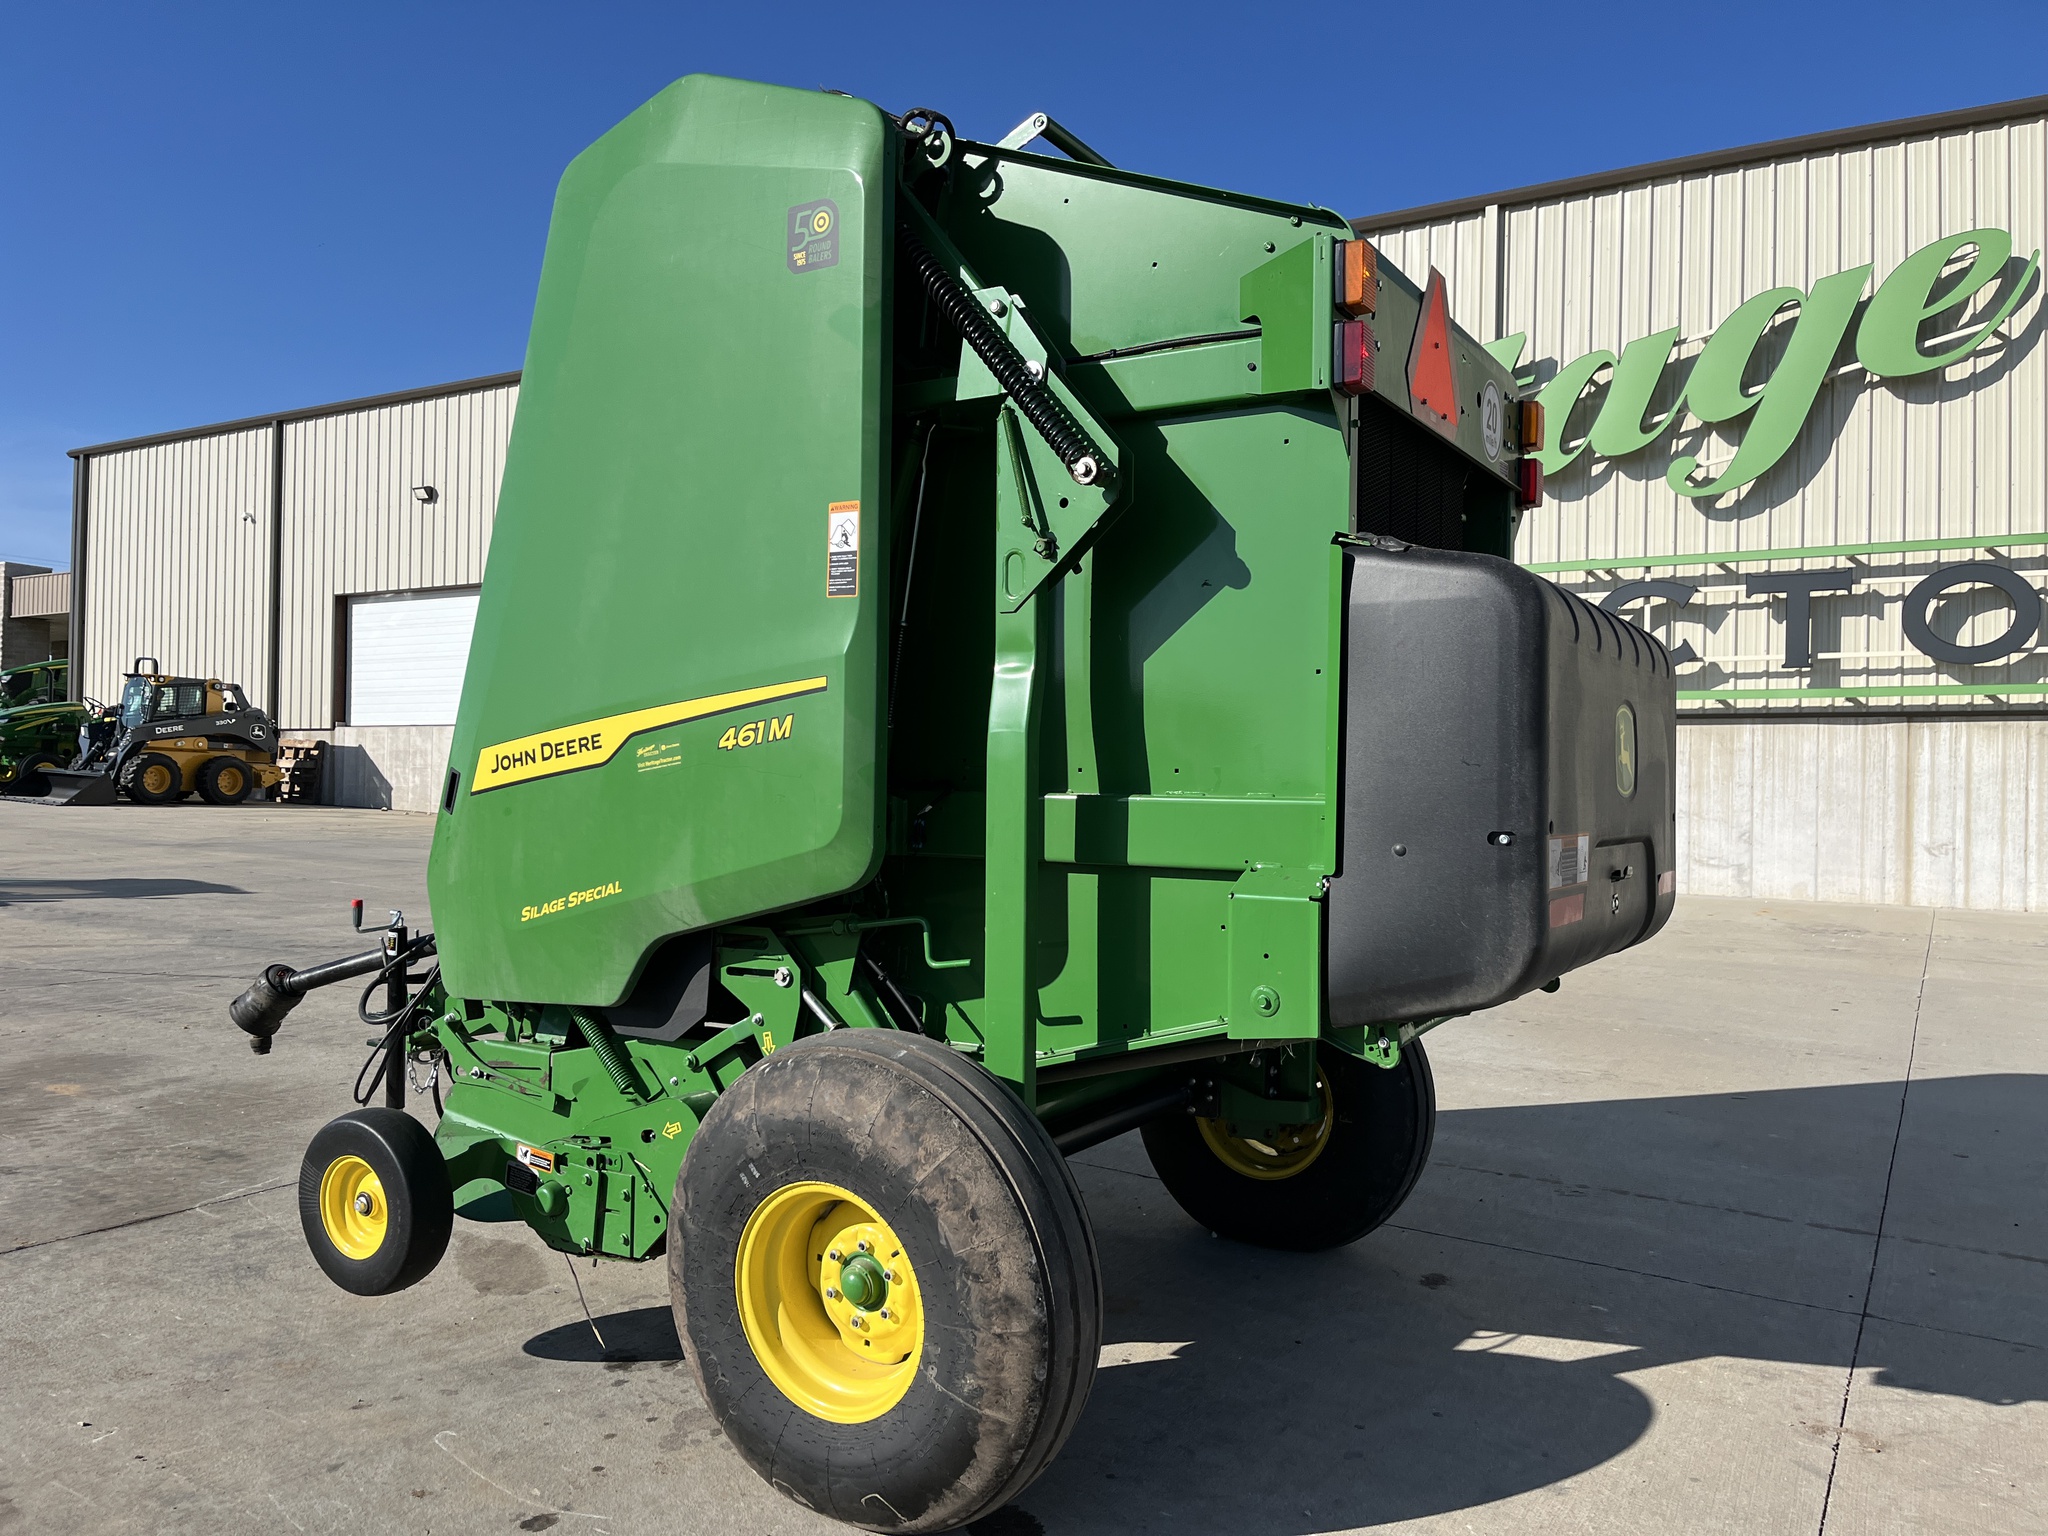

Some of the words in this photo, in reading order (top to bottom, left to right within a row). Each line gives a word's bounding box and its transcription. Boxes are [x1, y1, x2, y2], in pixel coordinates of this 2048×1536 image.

[808, 240, 832, 254] ROUND
[808, 250, 832, 264] BALERS
[1483, 227, 2041, 498] age
[1486, 398, 1497, 435] 20
[834, 503, 859, 511] WARNING
[155, 724, 185, 735] DEERE
[491, 748, 537, 774] JOHN
[540, 733, 603, 762] DEERE
[521, 897, 566, 922] SILAGE
[567, 880, 623, 908] SPECIAL
